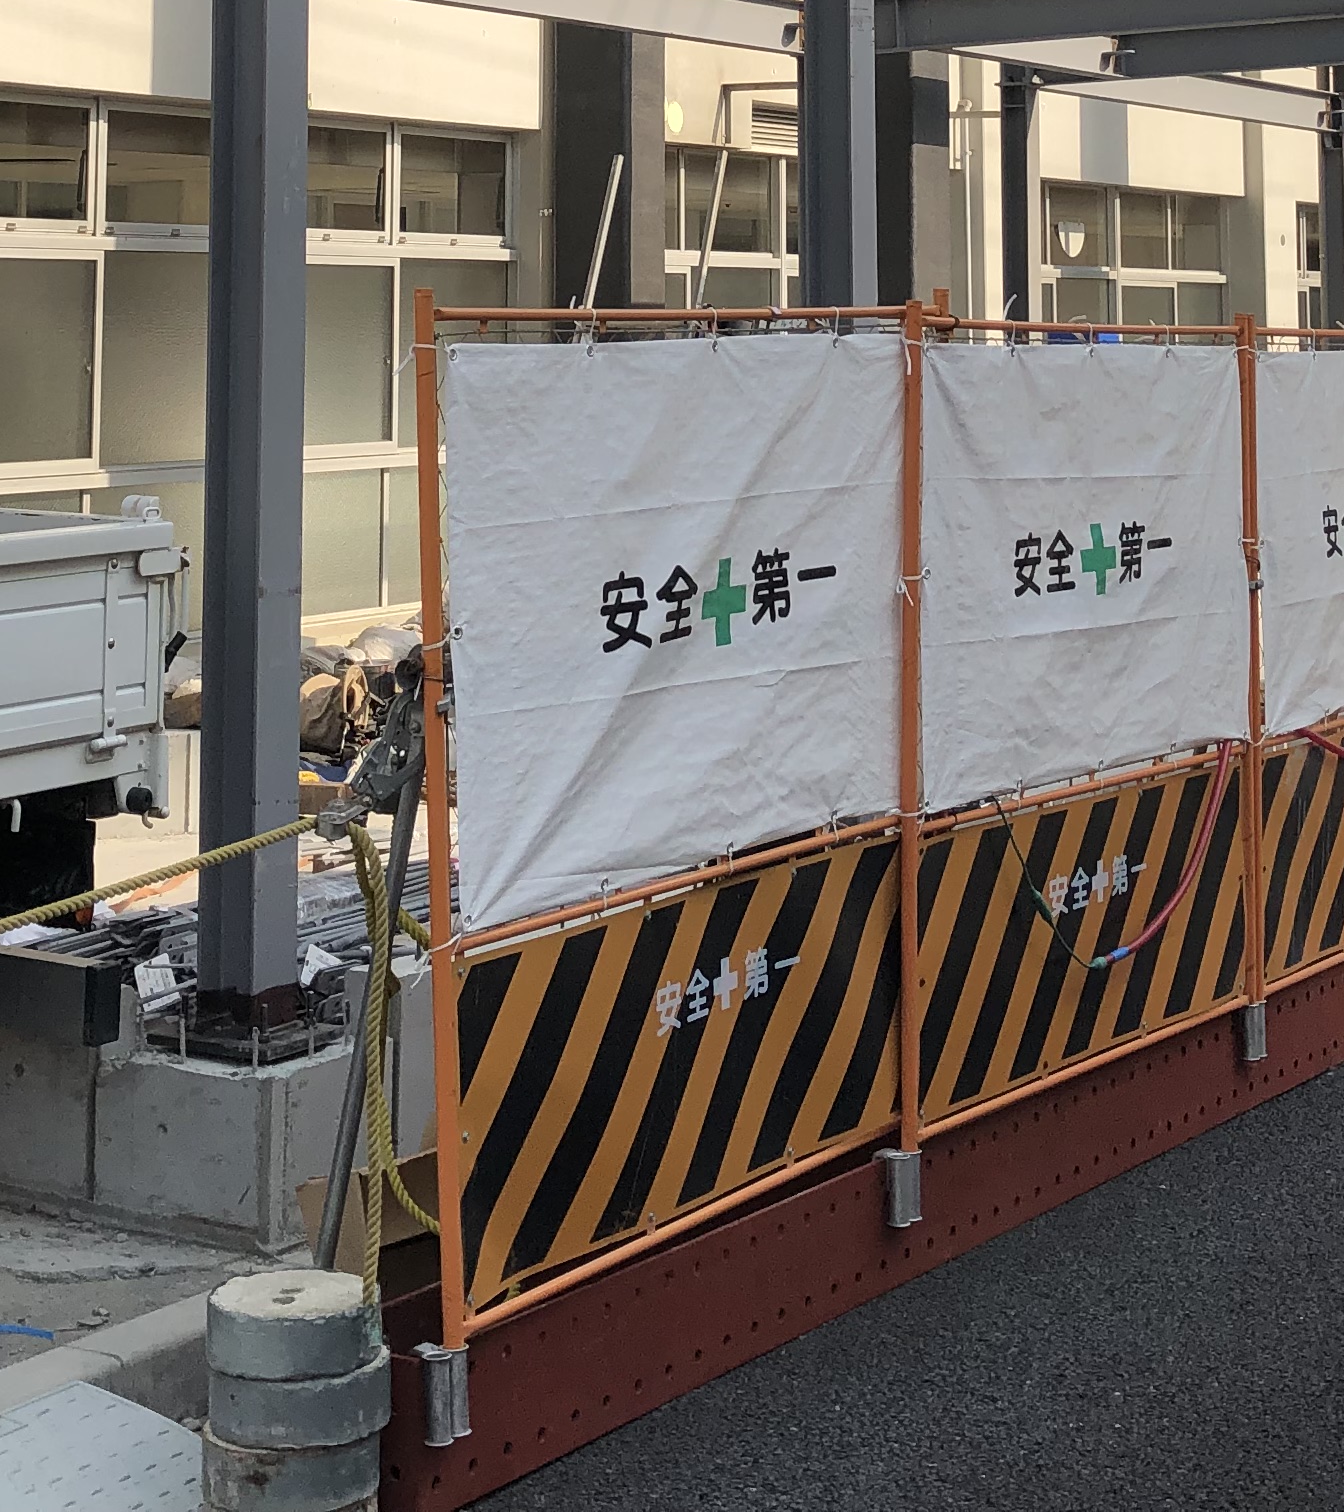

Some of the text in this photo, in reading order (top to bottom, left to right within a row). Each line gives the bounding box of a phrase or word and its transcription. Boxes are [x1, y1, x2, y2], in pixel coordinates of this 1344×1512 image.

[600, 547, 837, 654] 安全第一
[1013, 520, 1173, 597] 安全第一
[1048, 854, 1148, 917] 安全第一
[656, 945, 801, 1037] 安全第一
